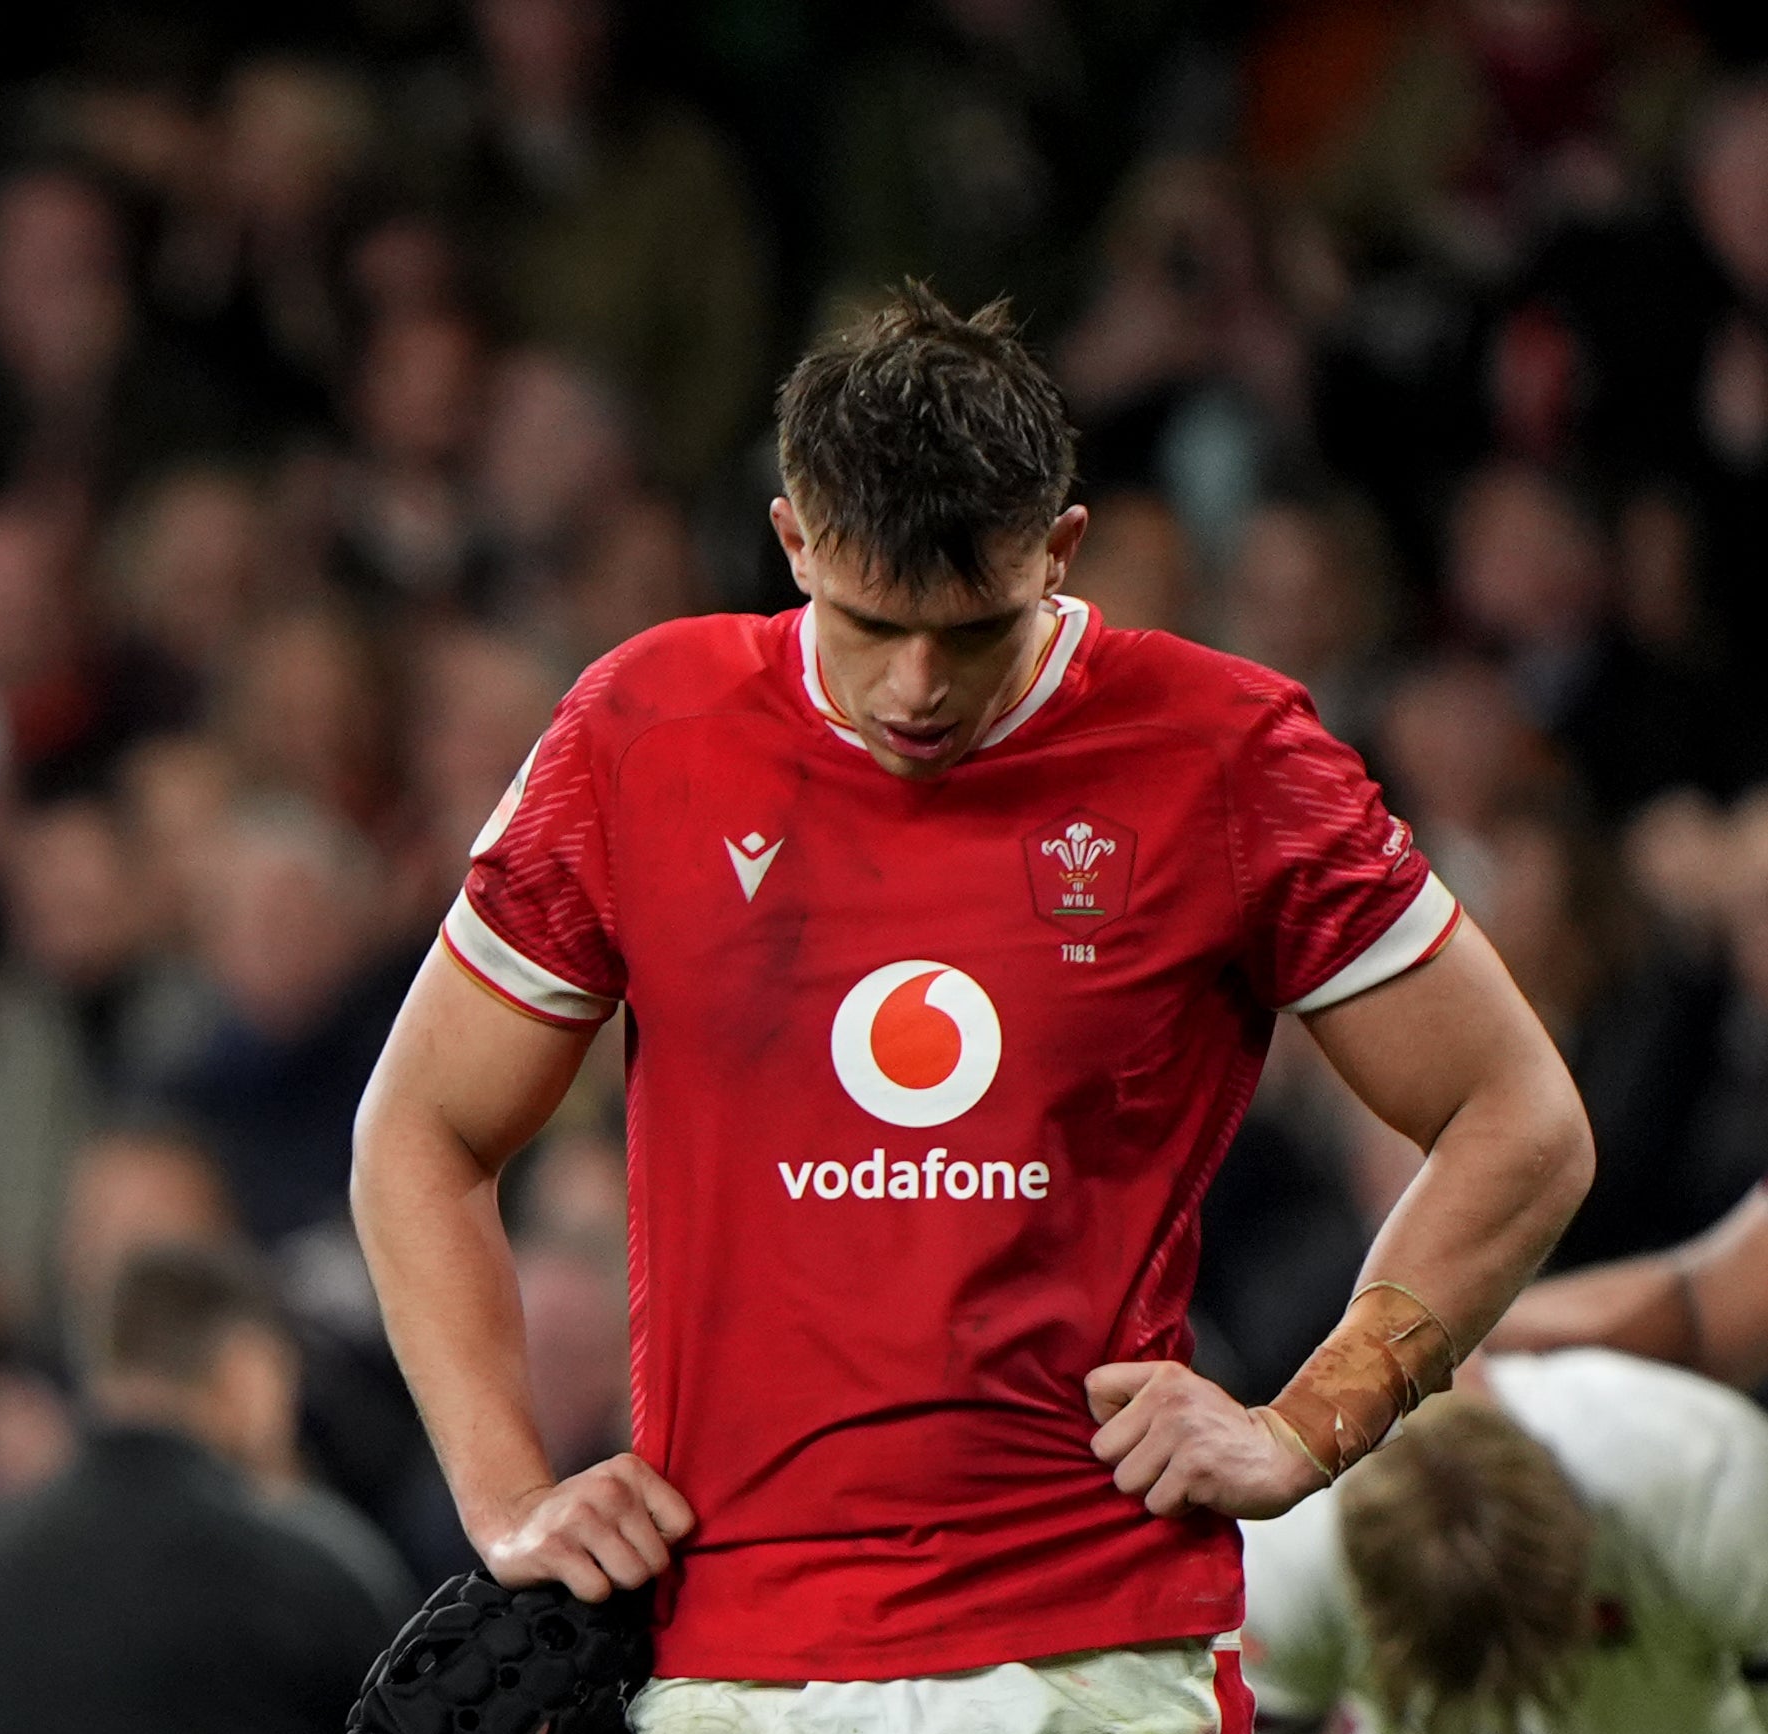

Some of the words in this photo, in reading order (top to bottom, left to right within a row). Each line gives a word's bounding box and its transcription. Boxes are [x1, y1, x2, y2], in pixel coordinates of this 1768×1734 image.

[1062, 893, 1095, 908] WRU
[1061, 943, 1096, 964] 1183
[777, 1147, 1051, 1200] vodafone
